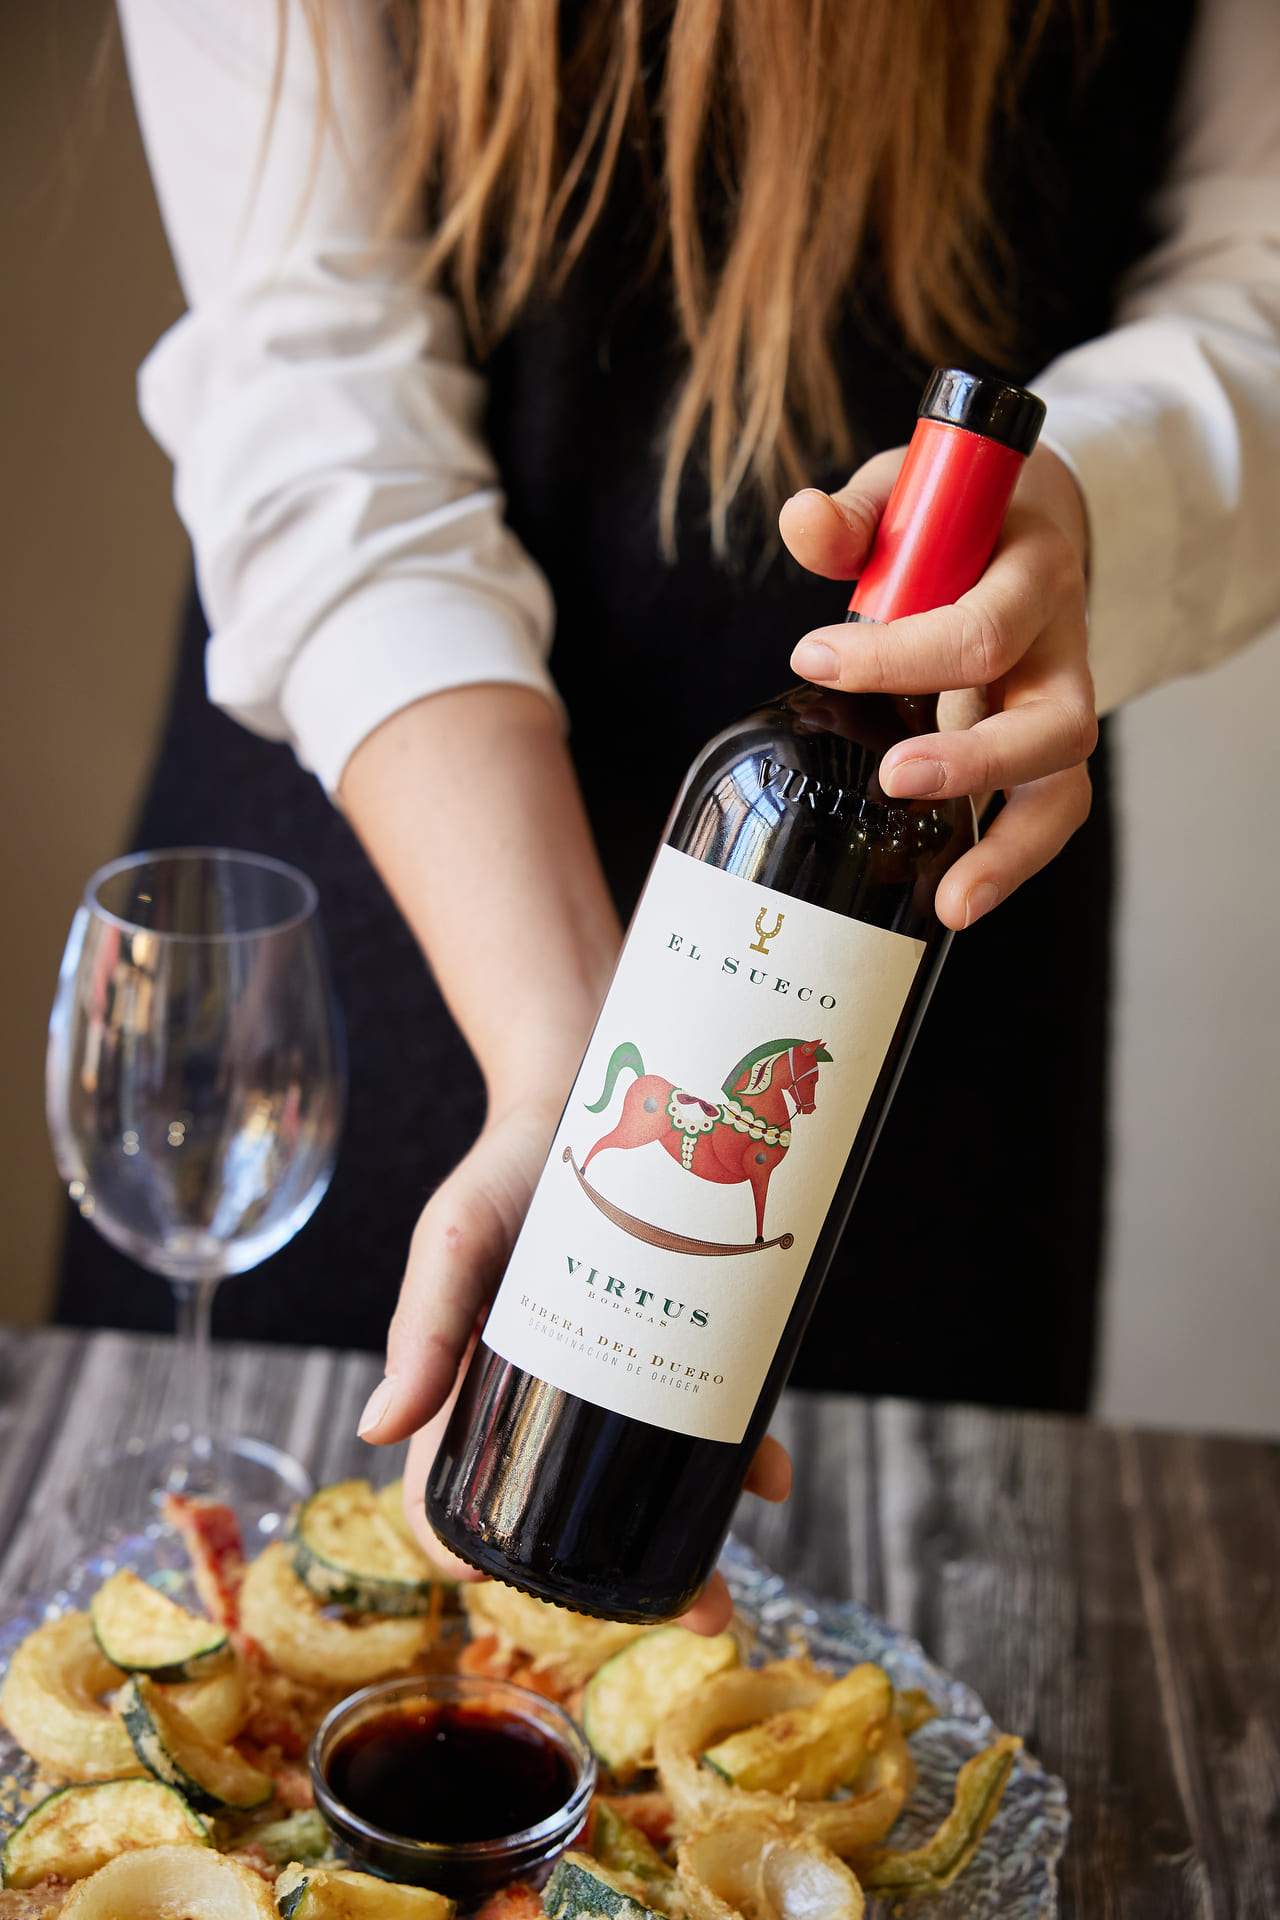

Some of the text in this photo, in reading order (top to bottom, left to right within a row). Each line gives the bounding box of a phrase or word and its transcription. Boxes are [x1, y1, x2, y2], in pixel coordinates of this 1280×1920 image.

[667, 933, 836, 1009] EL SUECO
[566, 1256, 710, 1328] VIRTUS
[587, 1290, 668, 1328] BODEGAS
[520, 1295, 725, 1385] RIBERA DEL DUERO
[528, 1317, 701, 1393] DENOMINACIÓN DE ORIGEN
